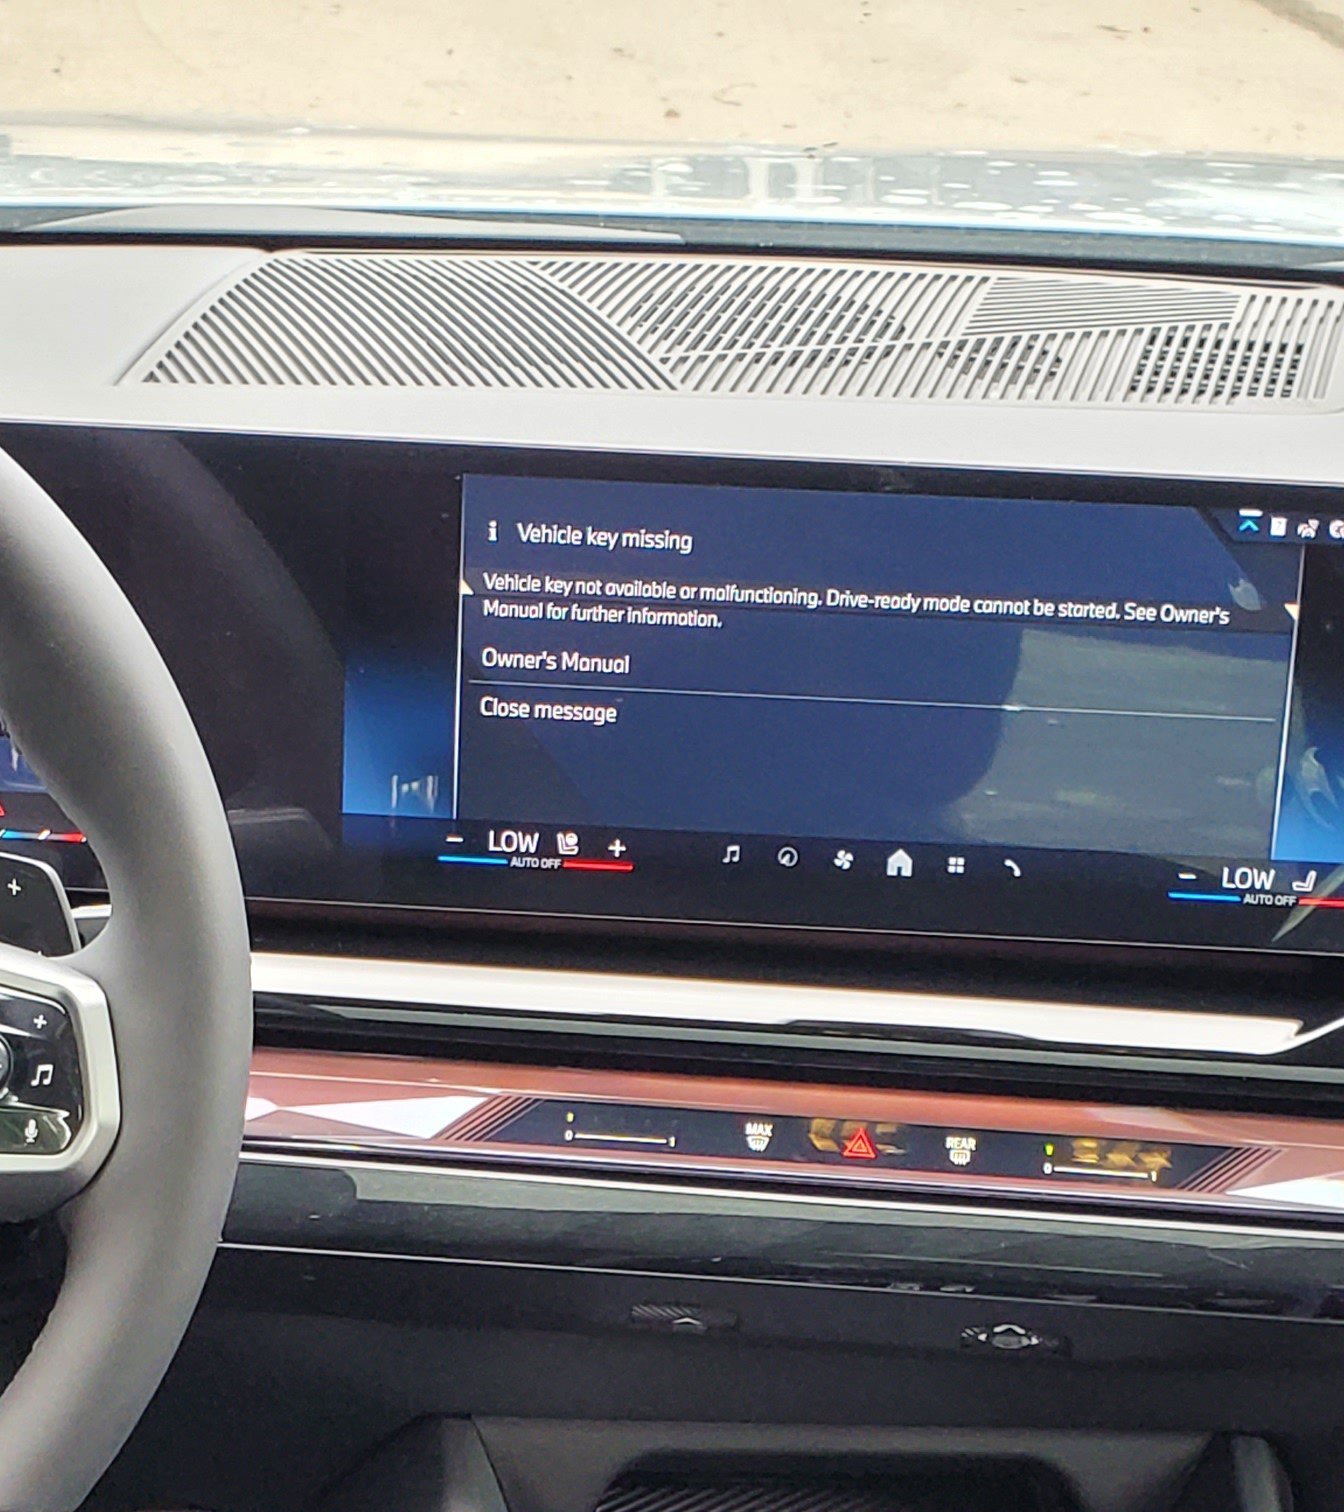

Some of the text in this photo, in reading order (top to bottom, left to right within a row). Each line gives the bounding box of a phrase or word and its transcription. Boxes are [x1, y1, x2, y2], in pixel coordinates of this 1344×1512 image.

[516, 522, 693, 554] Vehicle key missing
[483, 572, 1231, 625] Vehicle key not available or malfunctioning. Drive-ready mode cannot be started. See Owner's
[482, 599, 723, 629] Manual for further information.
[481, 647, 631, 675] Owner's Manual
[479, 696, 618, 727] Close message
[487, 829, 540, 854] LOW
[510, 856, 562, 870] AUTO OFF
[1221, 866, 1276, 891] LOW
[1243, 893, 1297, 907] AUTO OFF
[745, 1122, 773, 1136] MAX
[945, 1136, 977, 1151] REAR
